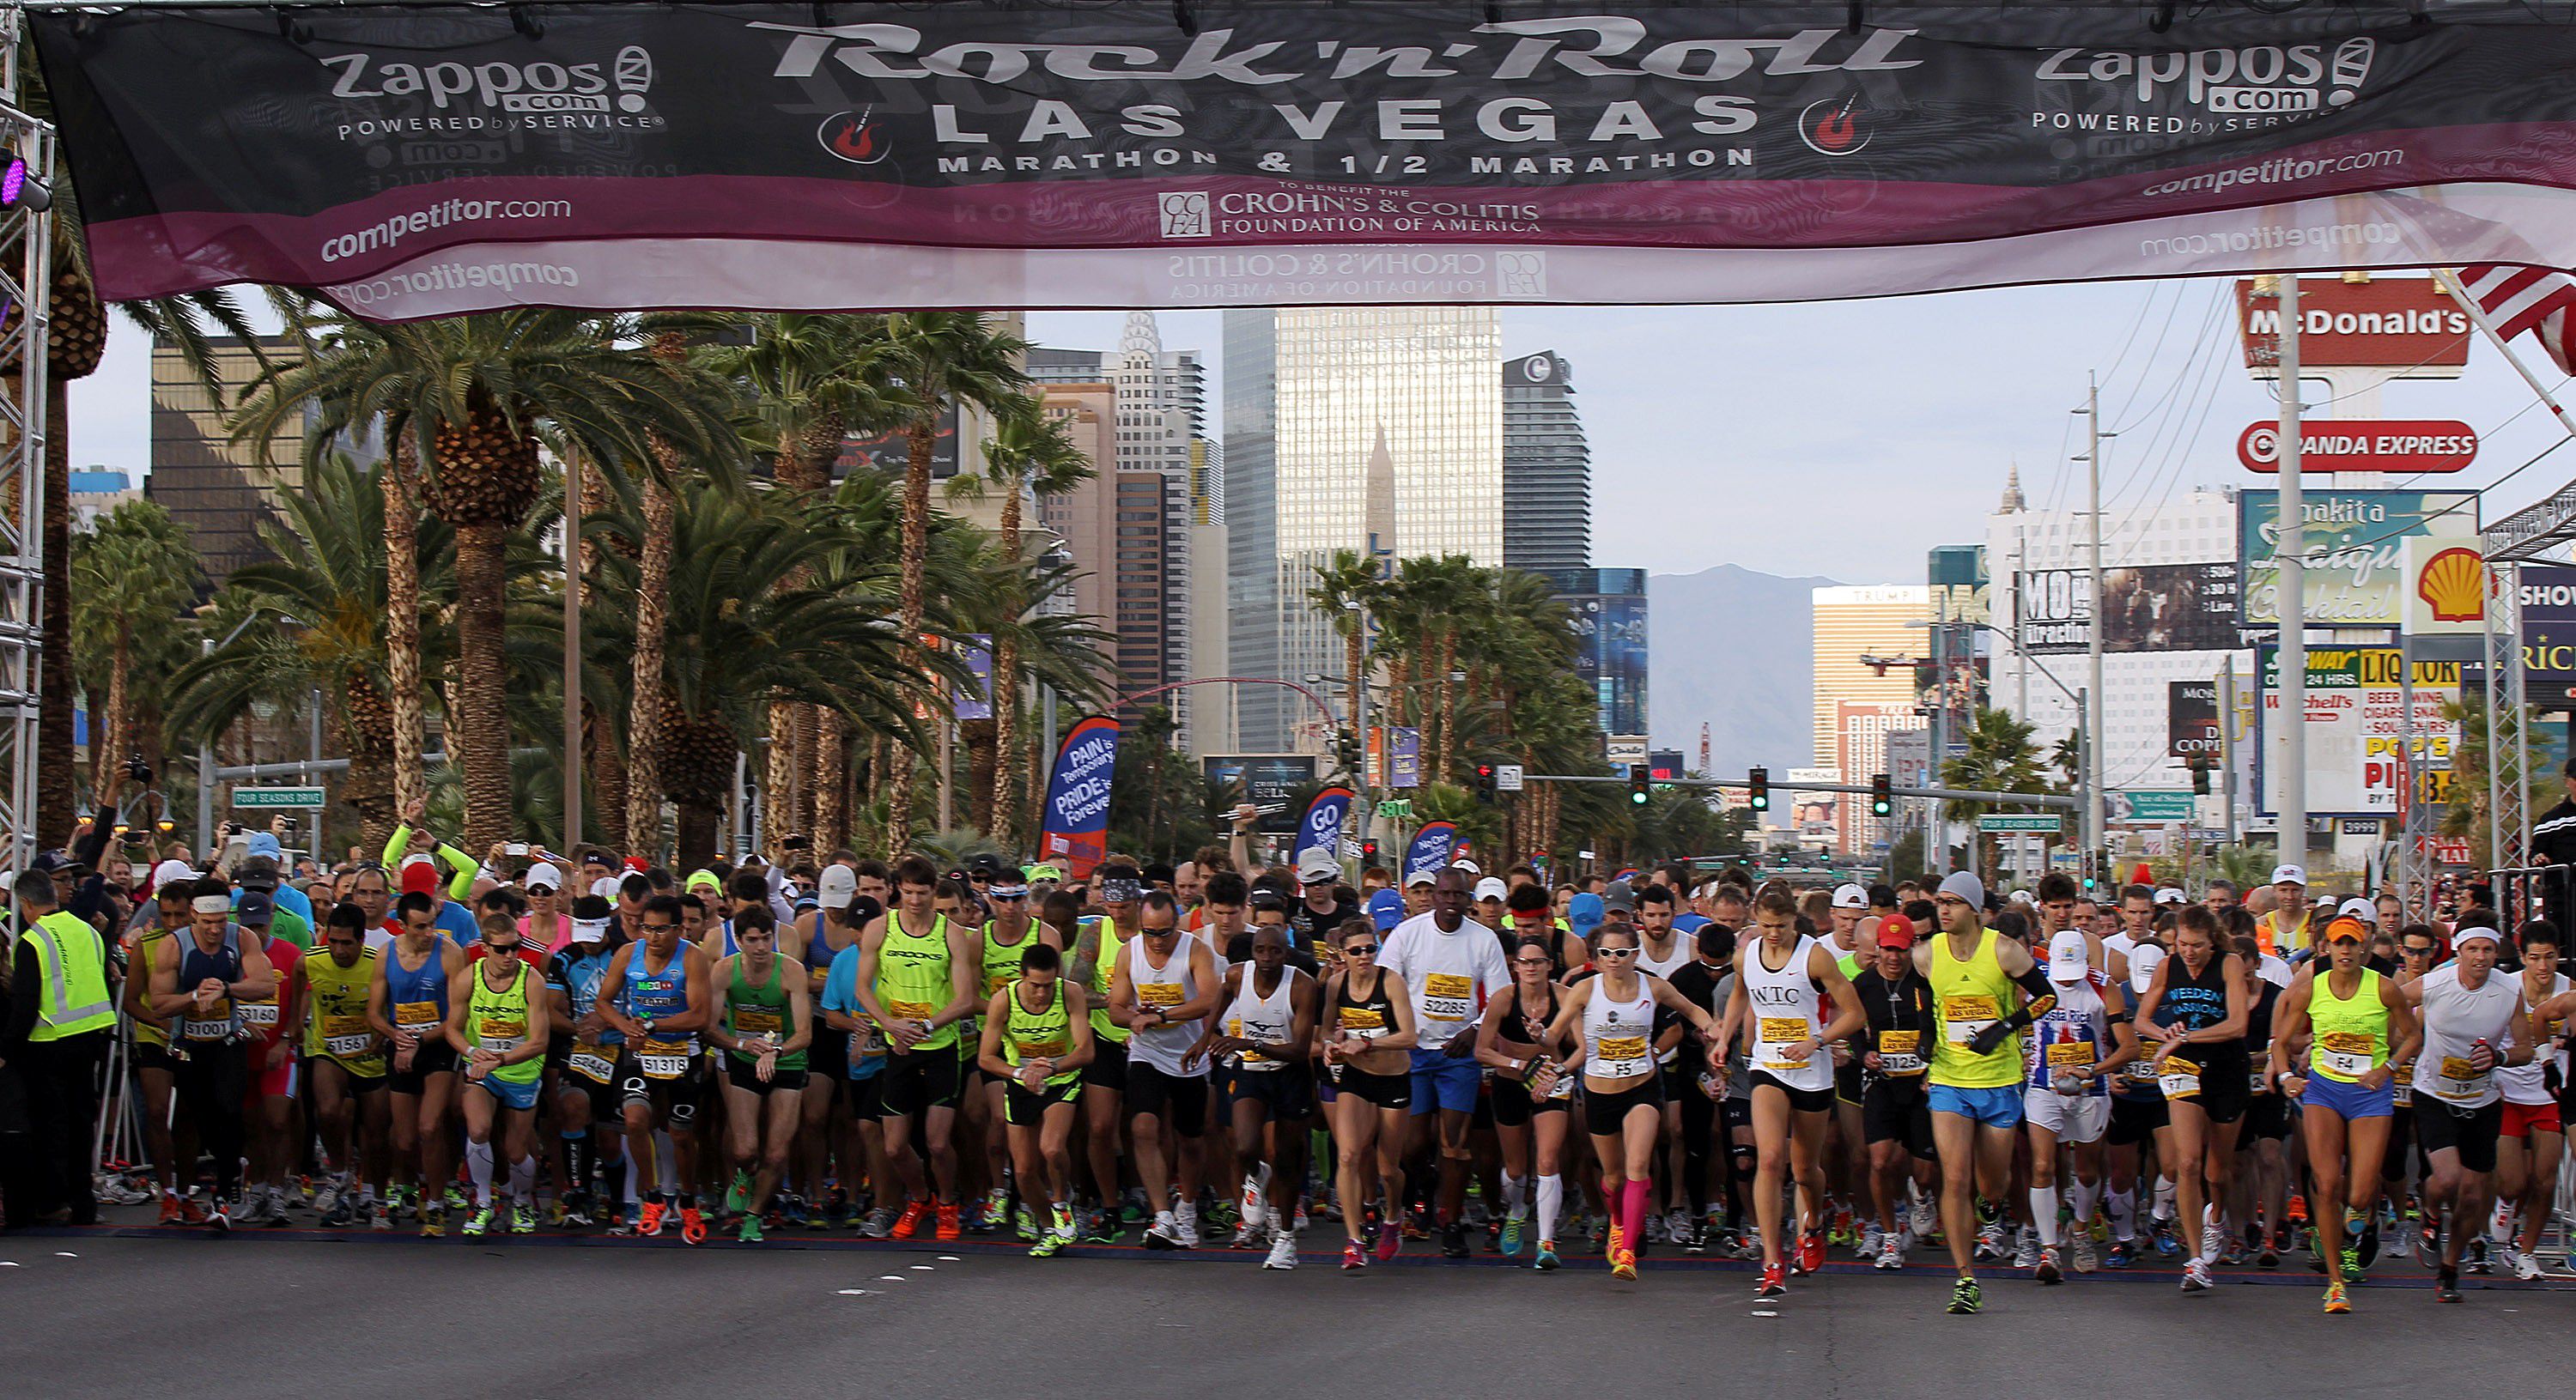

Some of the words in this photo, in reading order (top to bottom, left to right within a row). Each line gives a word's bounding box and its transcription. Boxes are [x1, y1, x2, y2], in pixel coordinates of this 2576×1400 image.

[746, 21, 1303, 85] Rock
[1471, 15, 1925, 82] Roll
[319, 53, 608, 108] Zappos
[2035, 45, 2323, 104] Zappos
[933, 99, 1186, 142] LAS
[1273, 95, 1759, 142] VEGAS
[938, 148, 1218, 173] MARATHON
[1257, 151, 1291, 173] &
[1340, 155, 1427, 174] 1/2
[1471, 148, 1753, 174] MARATHON
[2142, 148, 2403, 197] competitor.com
[1279, 180, 1298, 190] TO
[1304, 184, 1373, 196] BENEFIT
[1378, 188, 1411, 198] THE
[1219, 191, 1370, 215] CROHN'S
[1378, 197, 1400, 215] &
[1406, 201, 1540, 221] COLITIS
[322, 198, 571, 263] competitor.com
[1222, 217, 1383, 234] FOUNDATION
[1393, 217, 1425, 232] OF
[1431, 218, 1542, 233] AMERICA
[2248, 310, 2468, 335] MDonald's
[2374, 434, 2475, 456] EXPRESS
[2306, 674, 2324, 685] 24
[2367, 692, 2400, 704] BEER
[1069, 737, 1104, 768] PAIN
[236, 793, 257, 803] FOUR
[258, 793, 295, 803] SEASONS
[296, 793, 321, 803] DRIVE
[1054, 777, 1105, 815] PRIDE
[1311, 804, 1339, 831] GO
[2344, 821, 2378, 833] 3999
[885, 949, 943, 961] BROOKS
[1750, 986, 1800, 1004] WTC
[2045, 1009, 2066, 1021] osta
[185, 1021, 228, 1035] 51001
[644, 1058, 688, 1072] 51318
[1615, 1063, 1632, 1076] F5
[2337, 1056, 2354, 1070] F4
